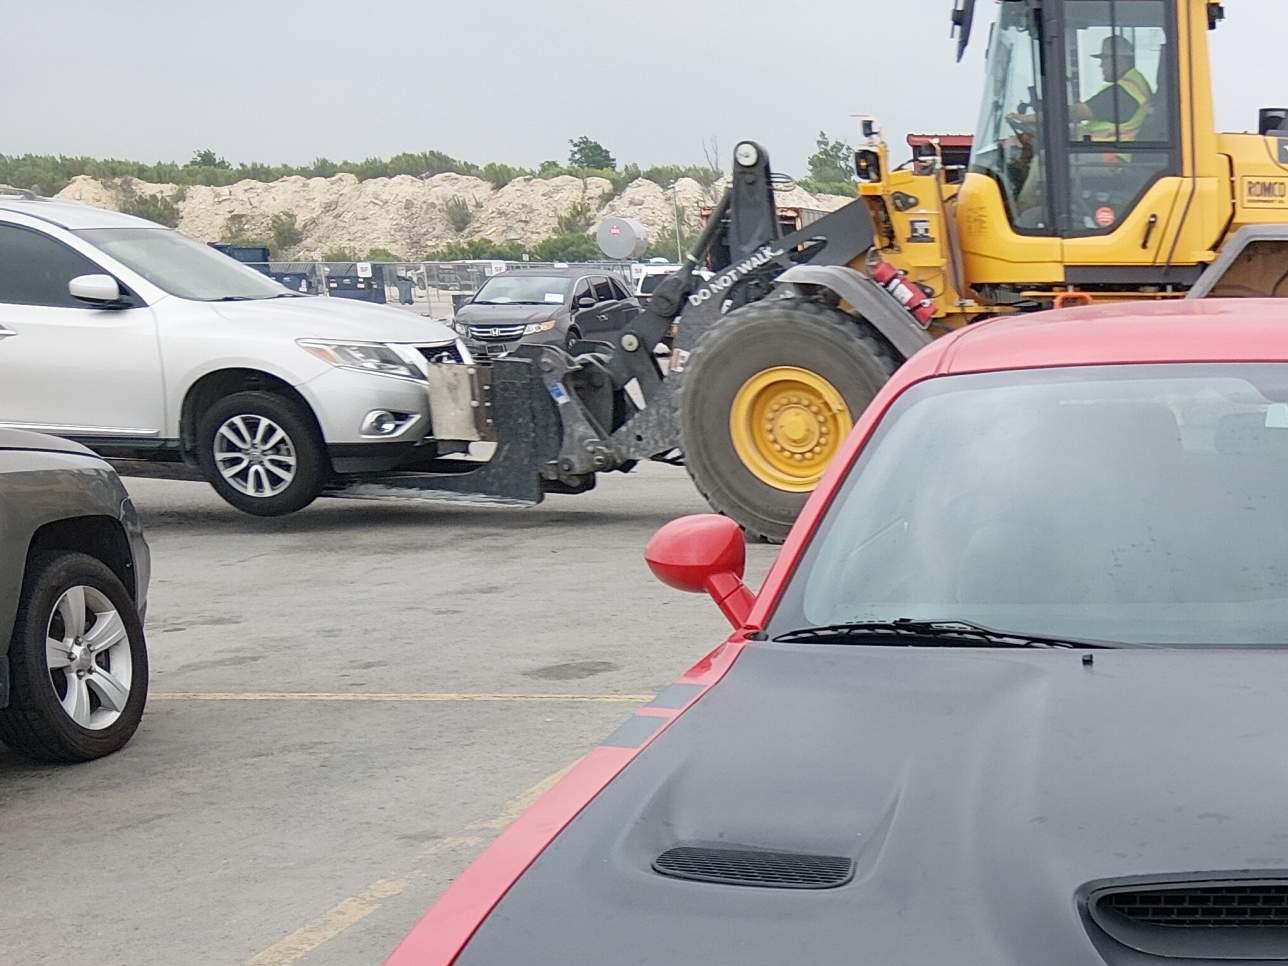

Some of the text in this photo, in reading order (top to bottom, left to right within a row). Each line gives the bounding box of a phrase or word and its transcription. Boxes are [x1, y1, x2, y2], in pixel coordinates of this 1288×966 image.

[688, 246, 775, 306] DO NOT WALK
